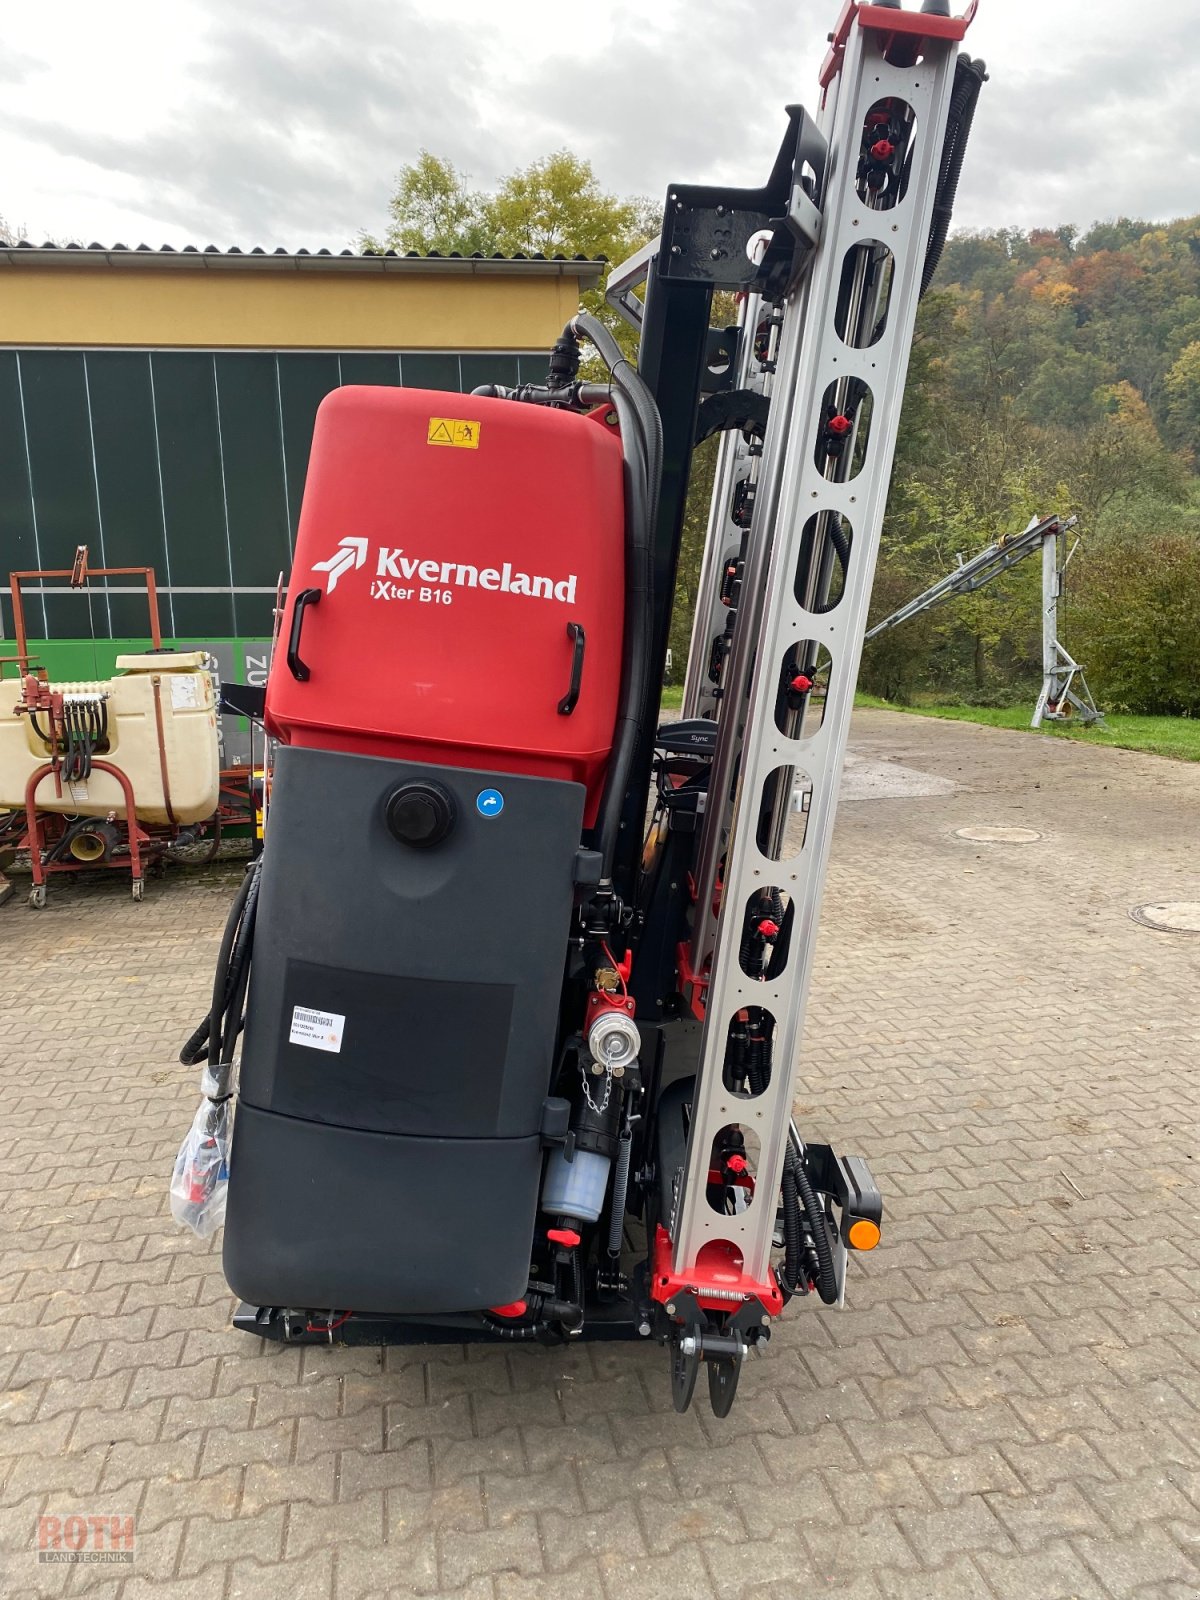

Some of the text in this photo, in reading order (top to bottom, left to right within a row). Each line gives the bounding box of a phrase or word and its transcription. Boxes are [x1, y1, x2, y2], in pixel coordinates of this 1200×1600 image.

[376, 547, 577, 604] Kverneland
[370, 580, 452, 605] iXter B16
[690, 734, 709, 743] Sync
